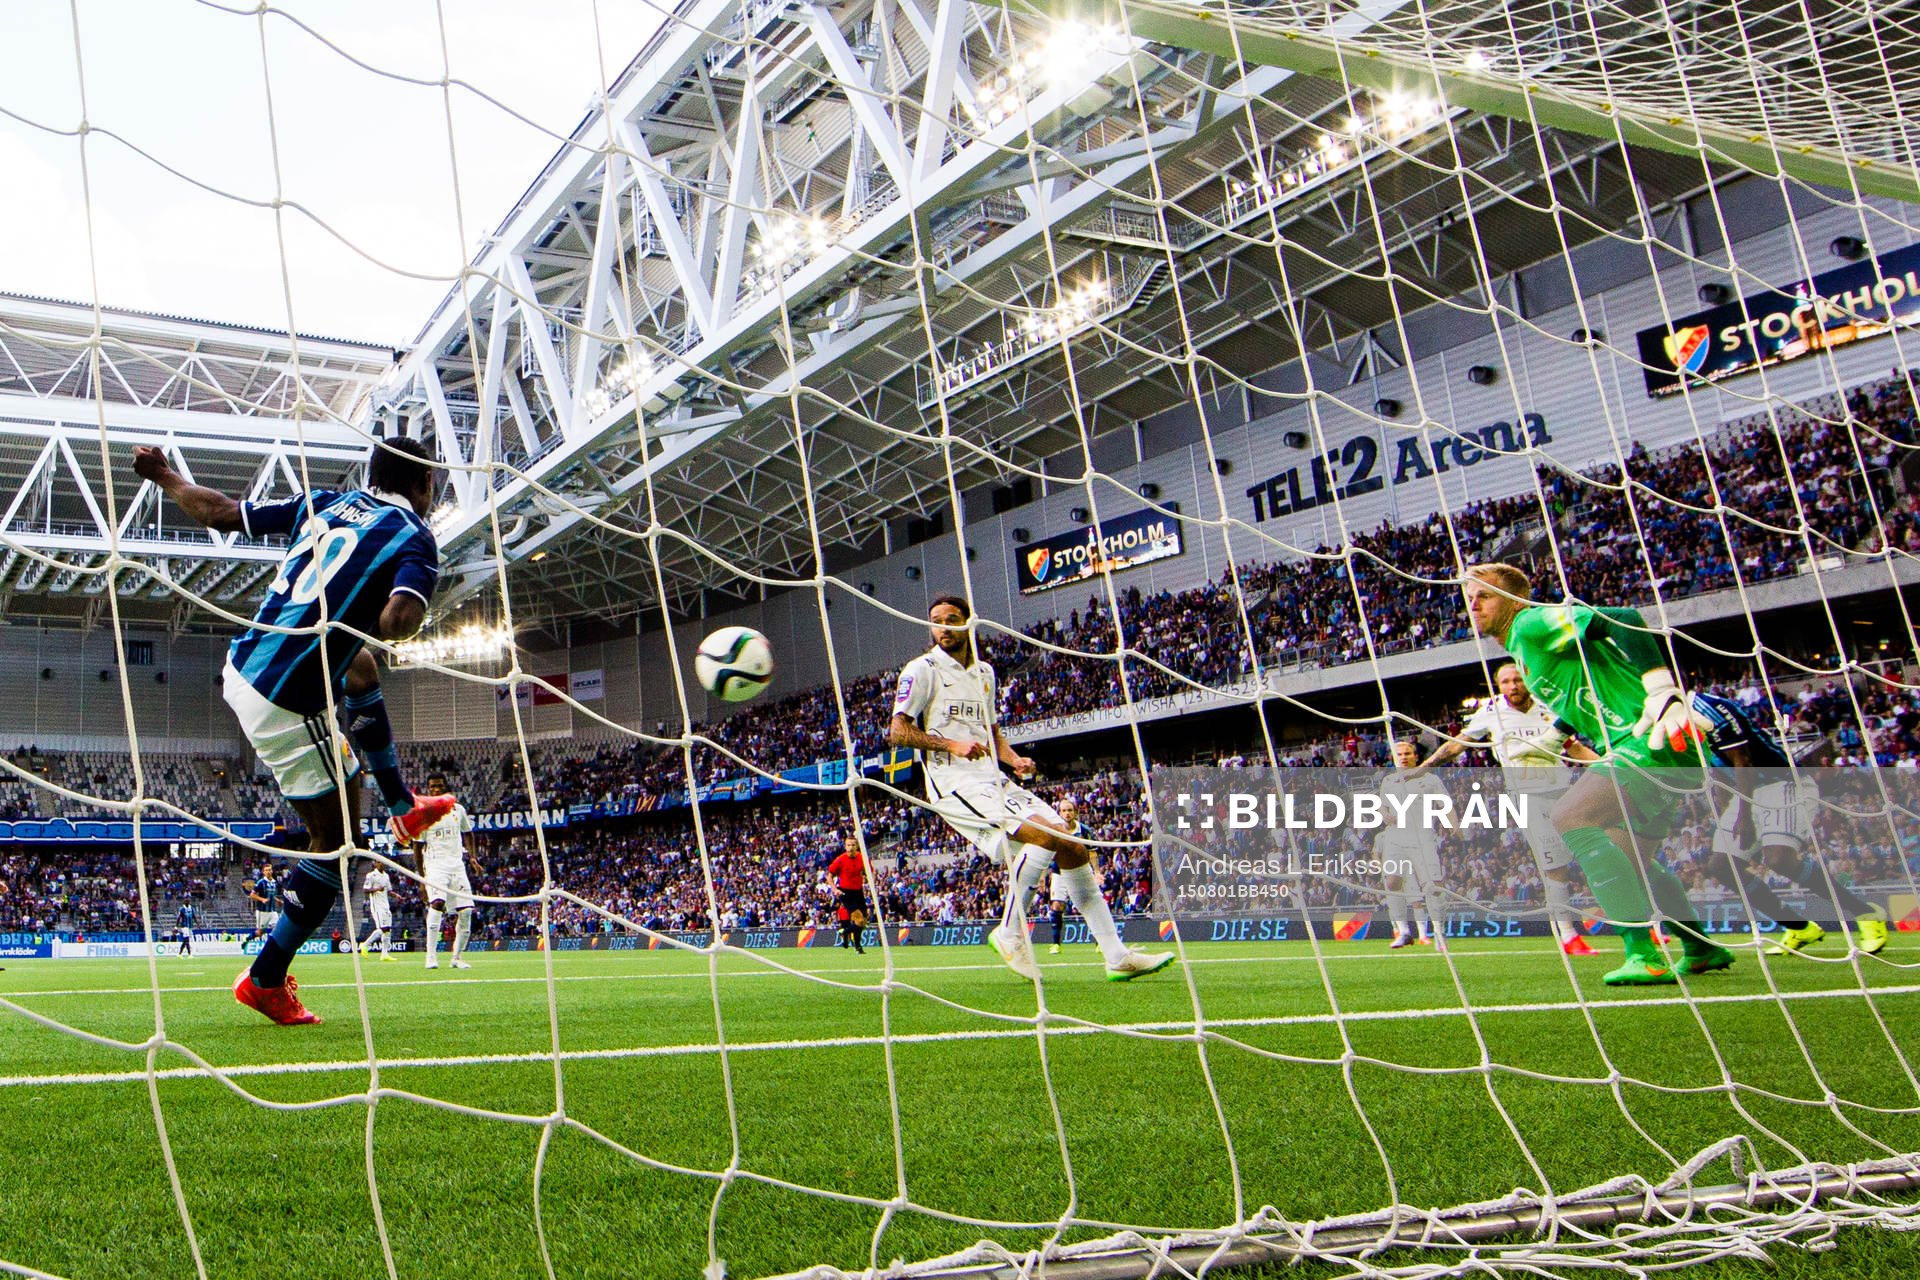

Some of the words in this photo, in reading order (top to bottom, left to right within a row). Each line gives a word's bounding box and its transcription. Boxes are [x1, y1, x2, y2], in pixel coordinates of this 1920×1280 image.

[1246, 435, 1384, 523] TELE2
[1392, 412, 1553, 485] Arena
[1053, 521, 1165, 569] STOCKHOLM
[268, 516, 359, 604] 20
[1543, 851, 1554, 865] 5
[744, 932, 781, 949] DIF.SE
[931, 925, 982, 946] DIF.SE
[1210, 919, 1289, 942] DIF.SE
